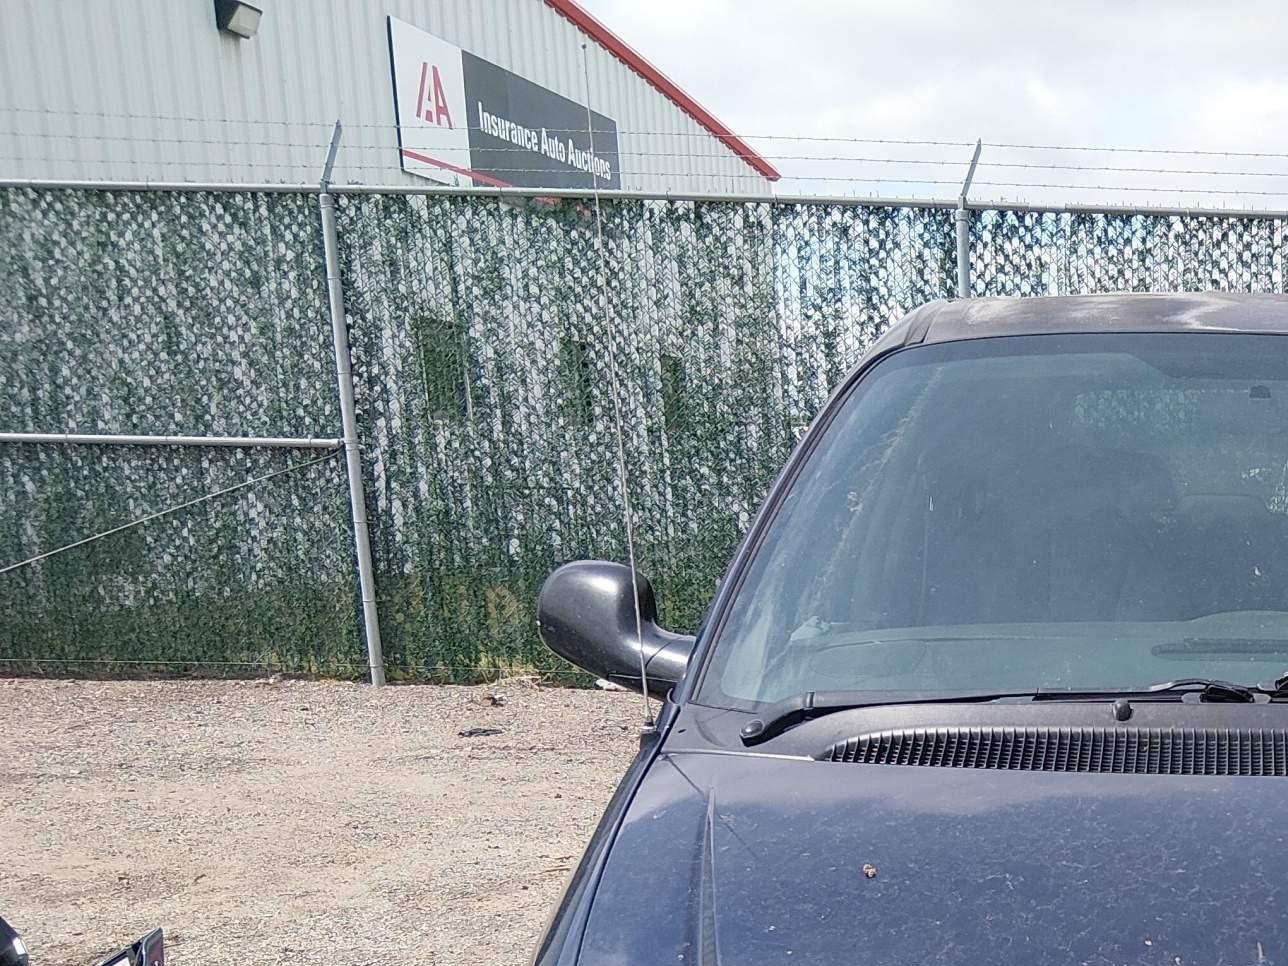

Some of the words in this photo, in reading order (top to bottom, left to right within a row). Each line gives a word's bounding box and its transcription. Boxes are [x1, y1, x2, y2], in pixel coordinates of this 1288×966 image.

[478, 100, 539, 152] Insurance
[541, 127, 566, 163] Auto
[567, 138, 612, 181] Auctions
